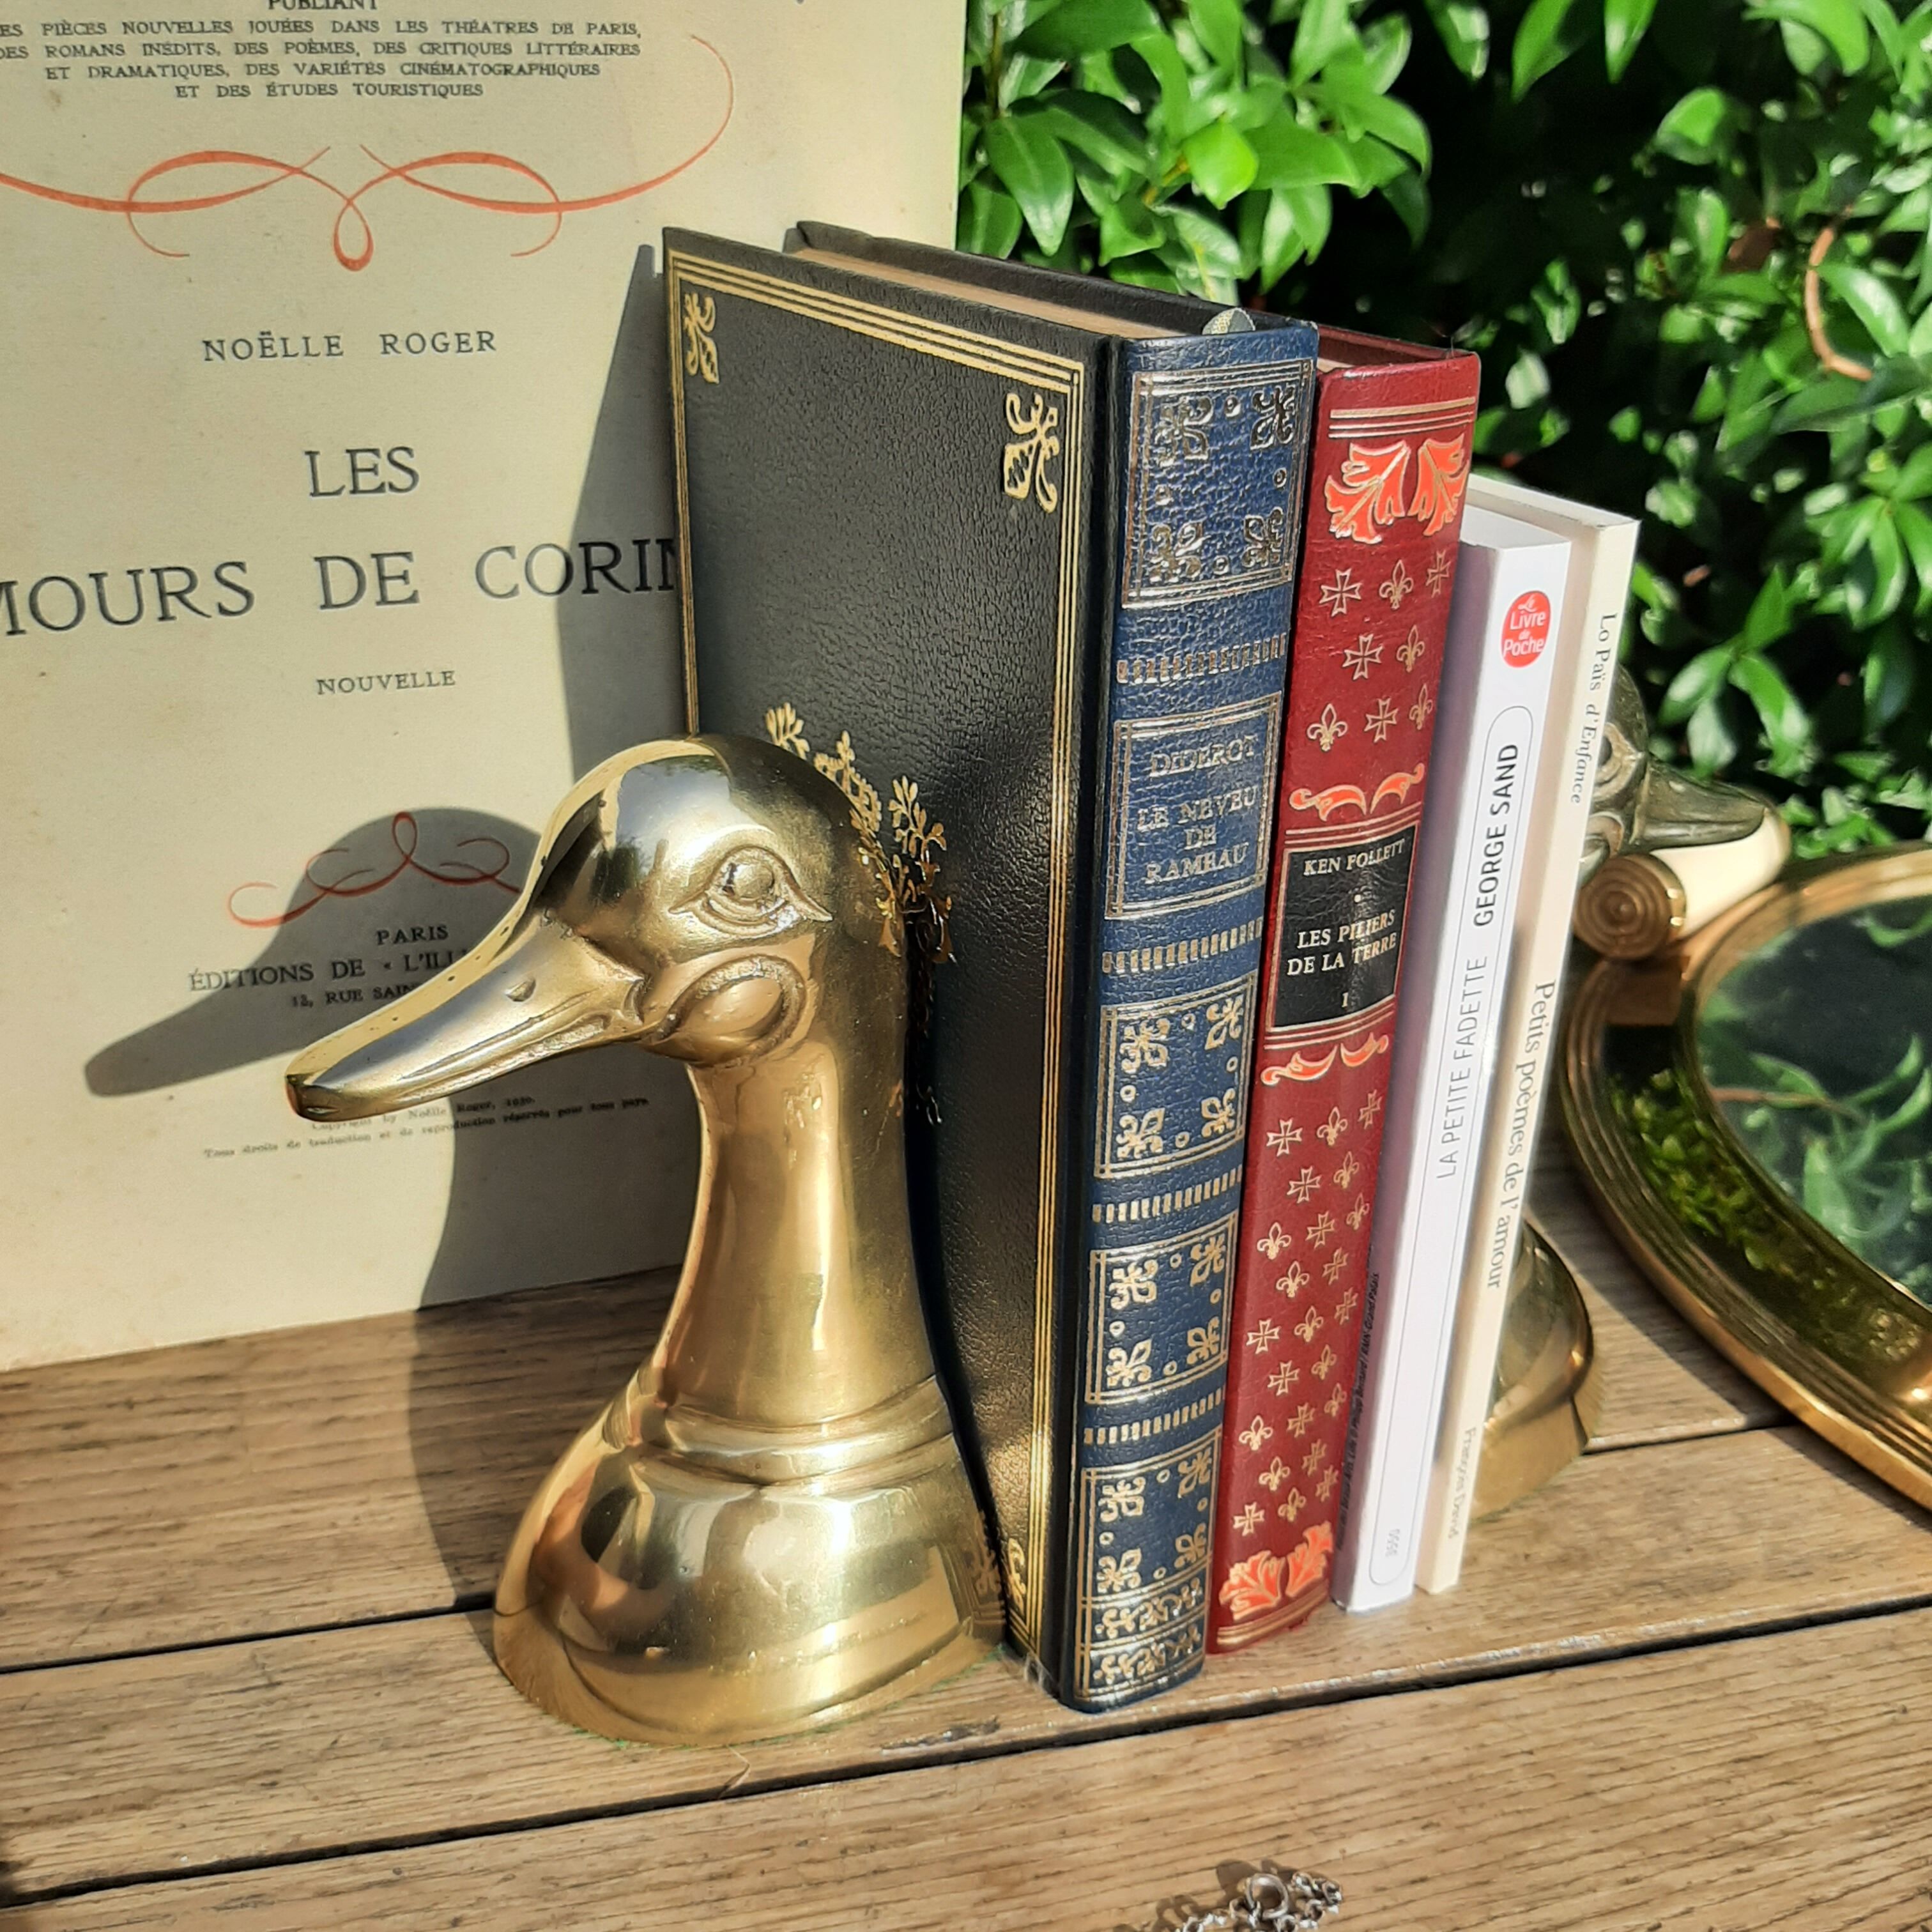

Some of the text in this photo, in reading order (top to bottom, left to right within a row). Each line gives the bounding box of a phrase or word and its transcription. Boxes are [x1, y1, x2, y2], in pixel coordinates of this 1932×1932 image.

[268, 0, 377, 10] PUBLIANT
[0, 19, 641, 38] ES PIÈCES NOUVELLES JOUÉES DANS LES THÉATRES DE PARIS,
[45, 43, 125, 58] ROMANS
[234, 42, 268, 56] DES
[284, 39, 360, 57] POÈMES,
[373, 42, 406, 56] DES
[419, 42, 512, 57] CRITIQUES
[526, 40, 641, 56] LITTÉRAIRES
[46, 60, 601, 80] ET DRAMATIQUES, DES VARIÉTÉS CINÉMATOGRAPHIQUES
[175, 82, 484, 99] ET DES ÉTUDES TOURISTIQUES
[203, 330, 497, 362] NOËLLE ROGER
[304, 446, 420, 497] LES
[314, 551, 420, 610] DE
[1510, 610, 1547, 630] Livre
[1598, 612, 1618, 643] Lo
[1503, 636, 1545, 657] Poche
[317, 670, 456, 696] NOUVELLE
[1150, 735, 1259, 778] DIDEROT
[1137, 785, 1259, 832] LE NEVEU
[1184, 824, 1218, 850] DE
[1144, 841, 1249, 885] RAMEAU
[1303, 838, 1406, 876] KEN FOLLETT
[376, 924, 449, 946] PARIS
[1297, 909, 1396, 949] LES PILIERS
[1287, 932, 1397, 976] DE LA TERRE
[1436, 744, 1518, 1179] LA PETITE FADETTE GEORGE SAND
[189, 962, 314, 992] ÉDITIONS
[332, 958, 366, 980] DE
[326, 989, 364, 1005] RUE
[1524, 979, 1556, 1055] Petits
[558, 1105, 583, 1118] pour
[590, 1101, 615, 1112] tous
[1508, 1059, 1538, 1158] poèmes
[1502, 1162, 1524, 1193] de
